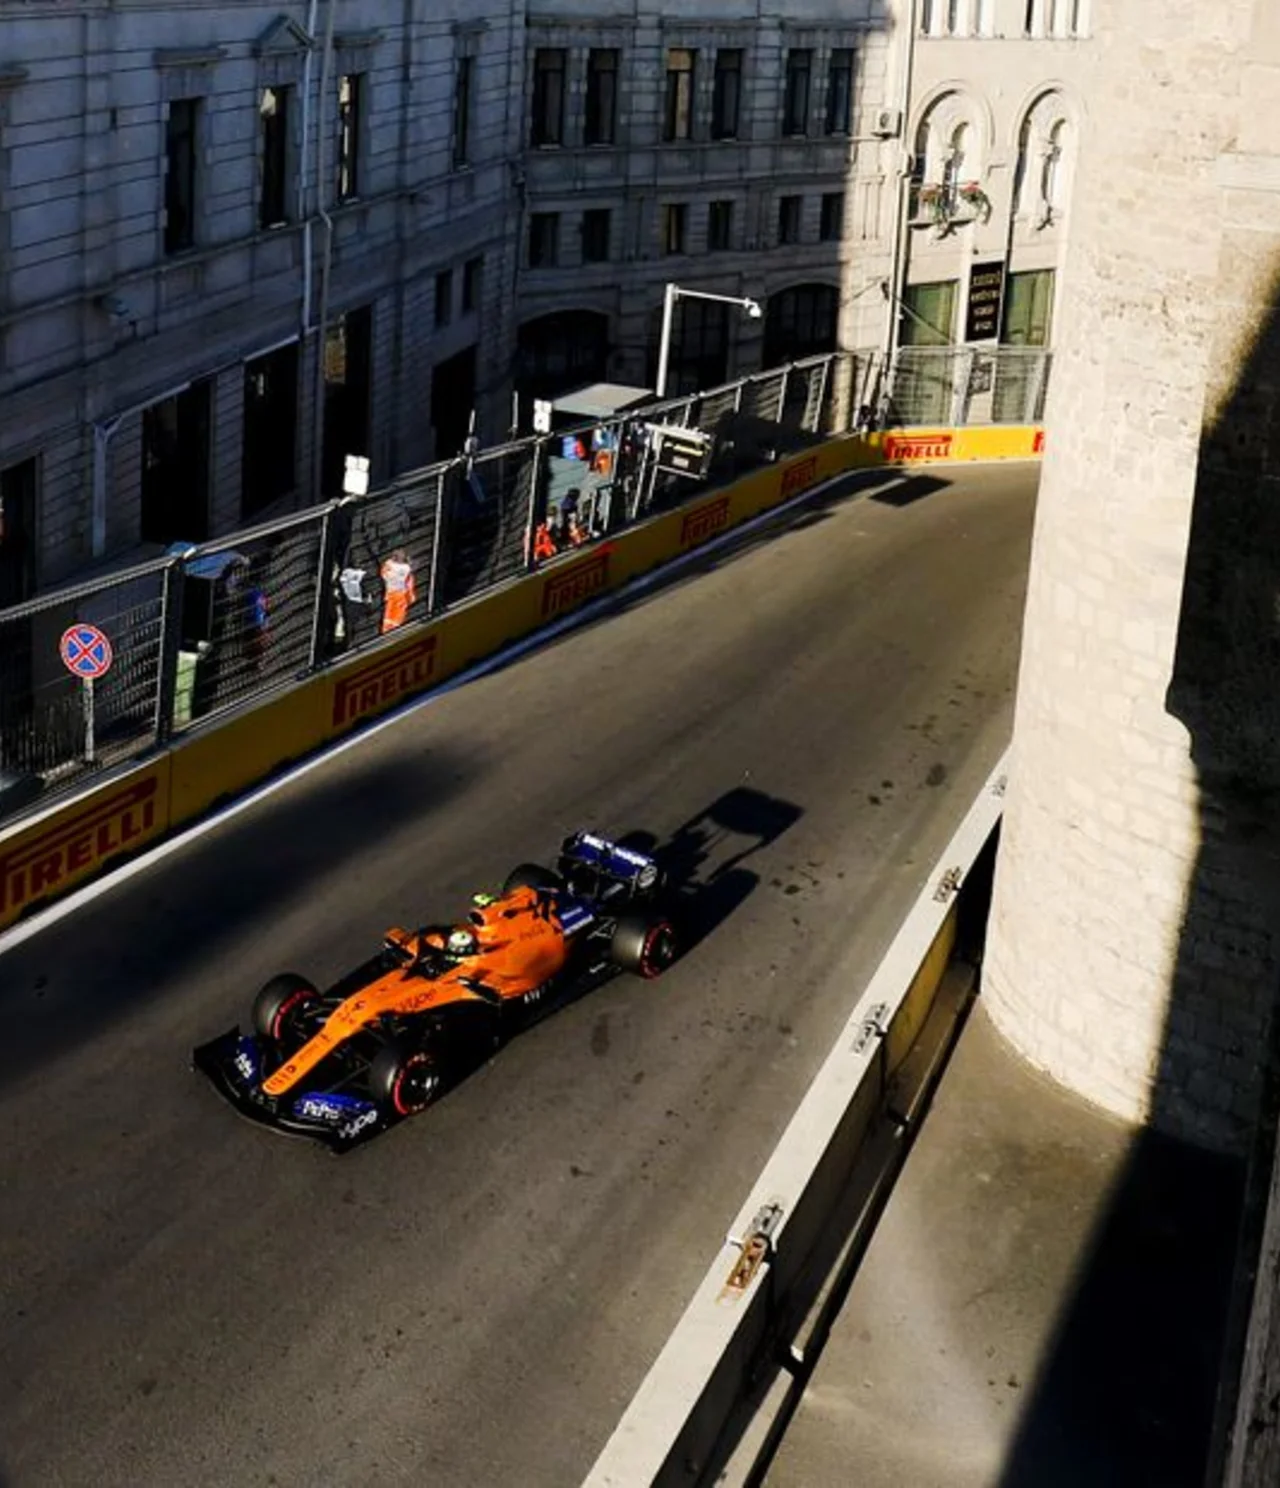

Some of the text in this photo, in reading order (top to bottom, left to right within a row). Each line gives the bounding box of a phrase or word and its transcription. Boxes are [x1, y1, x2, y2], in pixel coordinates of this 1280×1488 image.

[884, 434, 952, 460] PIRELLI
[541, 552, 609, 617] PIRELLI
[332, 635, 438, 727] PIRELLI
